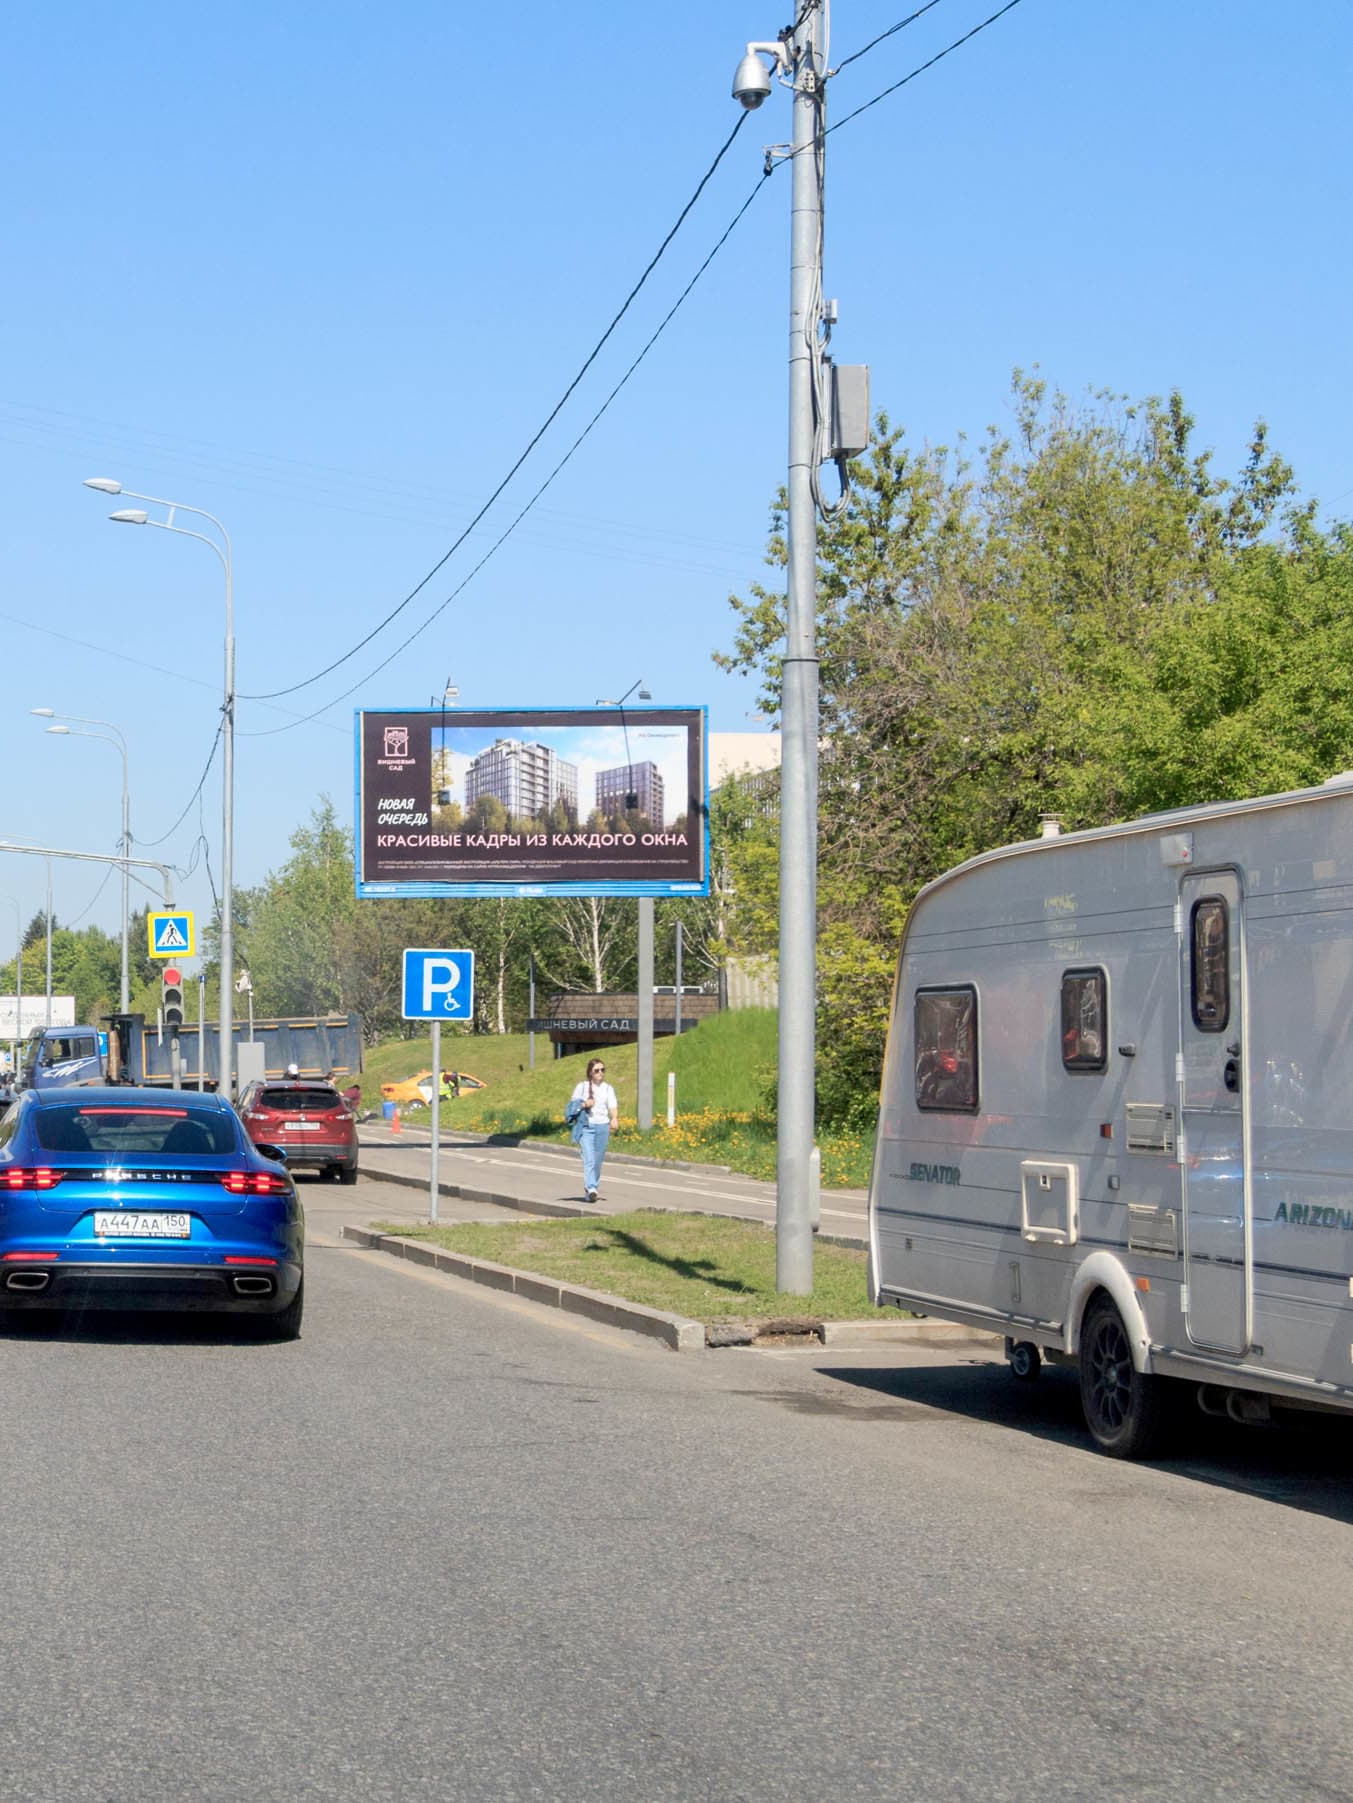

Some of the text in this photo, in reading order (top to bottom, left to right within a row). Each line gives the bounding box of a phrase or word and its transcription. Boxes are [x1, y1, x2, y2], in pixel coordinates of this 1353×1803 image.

[377, 798, 416, 810] НОВАЯ
[377, 813, 429, 826] ОЧЕРЕДЬ
[377, 833, 689, 849] КРАСИВЫЕ КАДРЫ ИЗ КАЖДОГО ОКНА
[422, 957, 461, 1012] P
[600, 1019, 630, 1030] САД
[92, 1172, 192, 1180] PRSCHE
[910, 1162, 961, 1186] SENATOR
[1274, 1201, 1353, 1231] ARIZON
